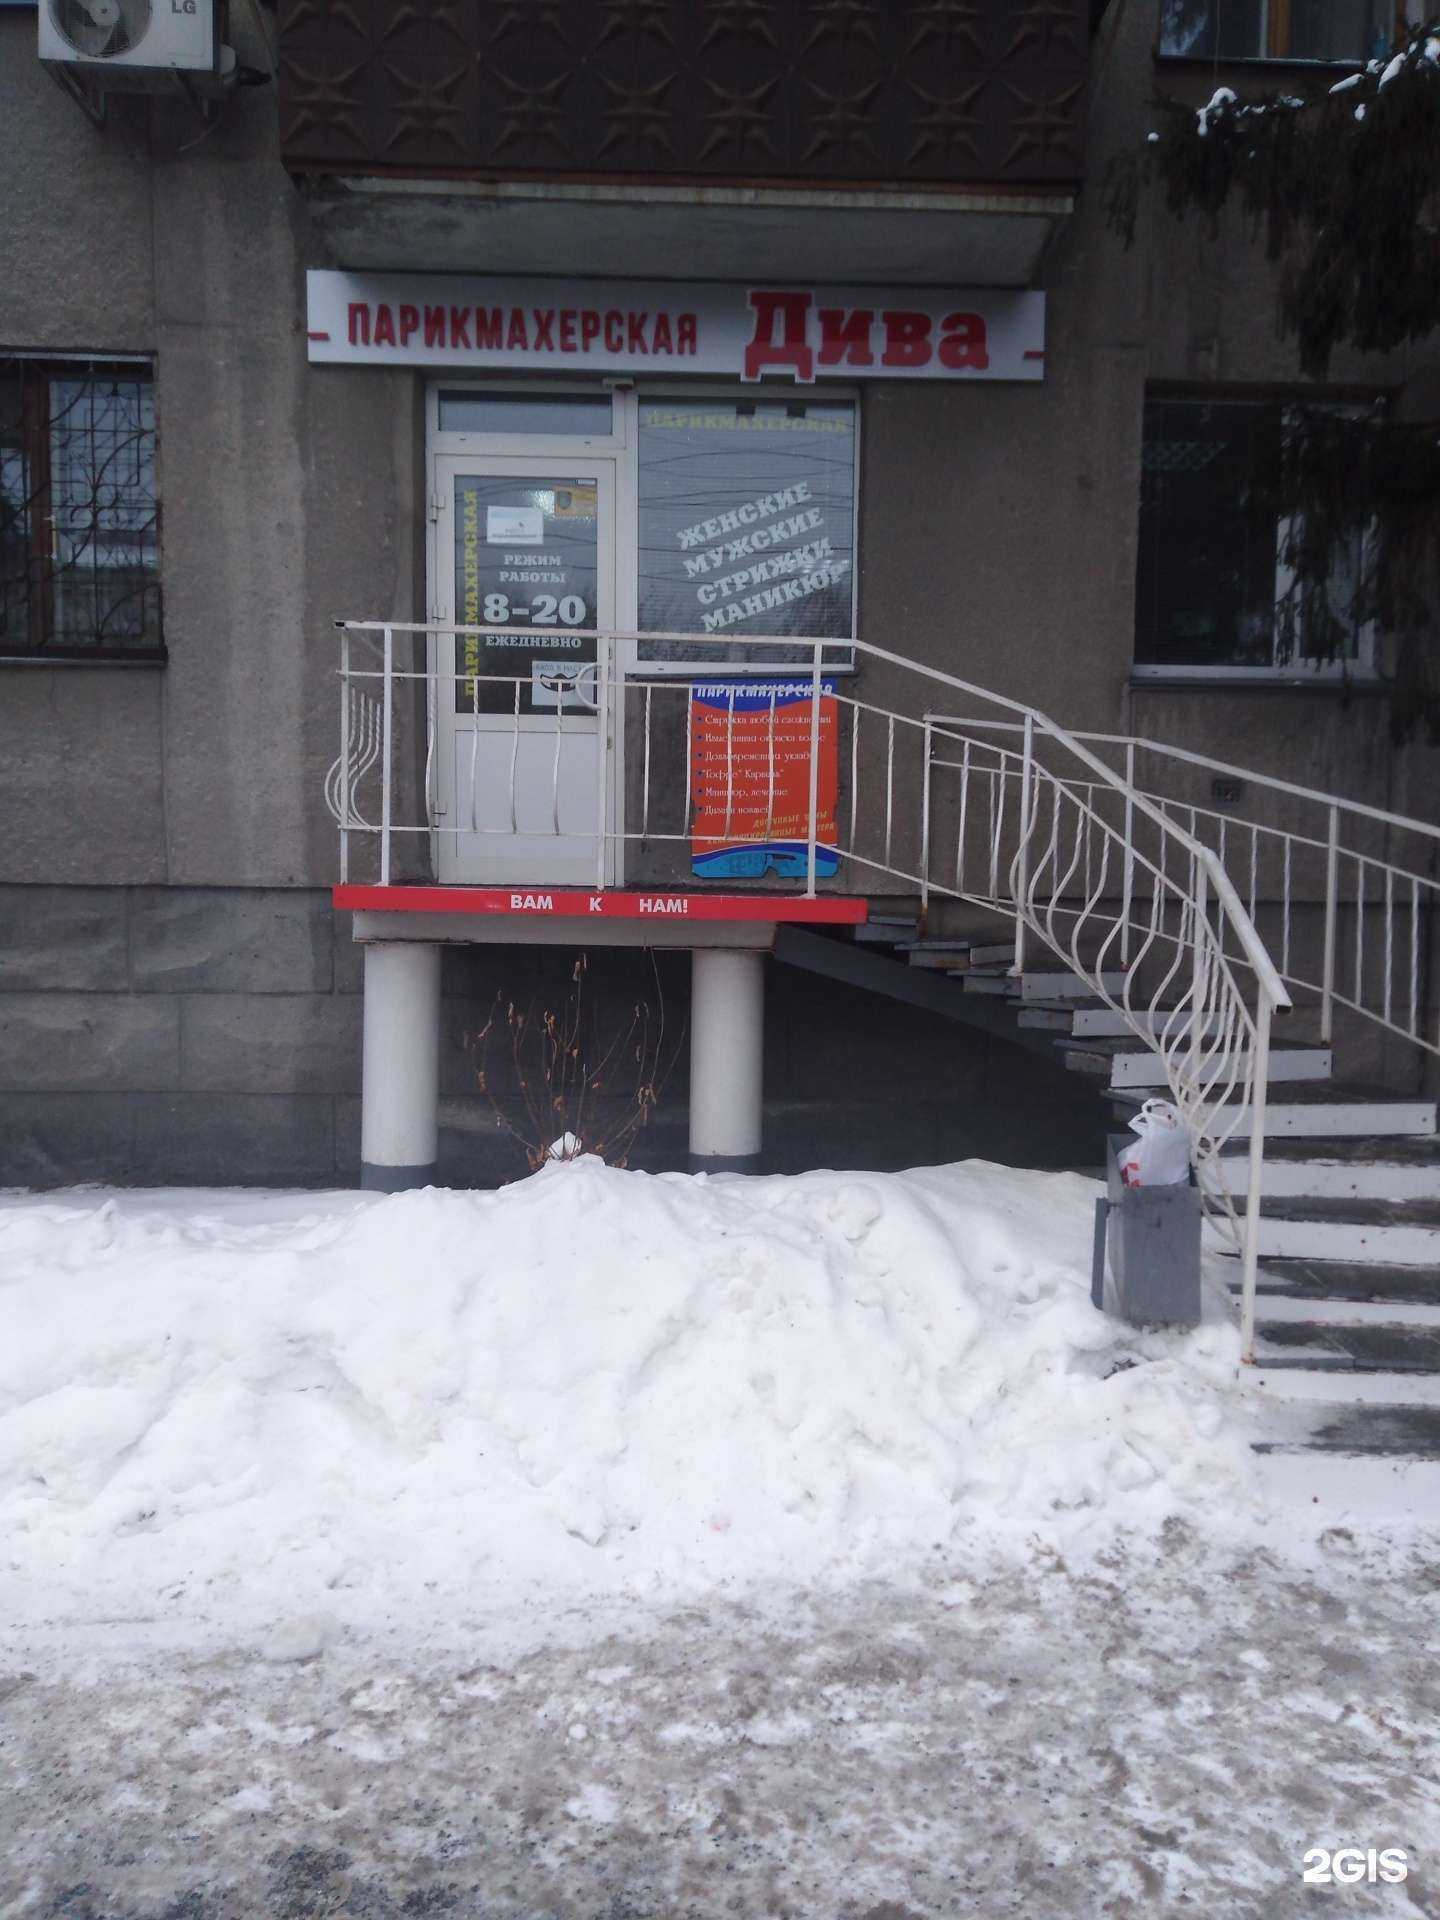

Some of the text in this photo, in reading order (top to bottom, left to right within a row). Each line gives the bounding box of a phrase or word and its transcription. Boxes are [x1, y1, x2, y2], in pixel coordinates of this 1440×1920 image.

[171, 0, 196, 15] LG
[347, 290, 990, 382] ПАРИКМАХЕРСКАЯ Дива
[676, 481, 812, 550] ЖЕНСКИЕ
[504, 554, 562, 567] РЕЖИМ
[682, 507, 825, 578] МУЖСКИЕ
[463, 490, 480, 697] ПАРИМАХЕРСКАЯ
[499, 571, 566, 584] РАБОТЫ
[696, 536, 834, 605] СТРИЖКИ
[483, 593, 587, 625] 8-20
[700, 559, 850, 633] МАНИКЮР
[485, 634, 582, 649] ЕЖЕДНЕВНО
[510, 894, 689, 914] ВАМ К НАМ!
